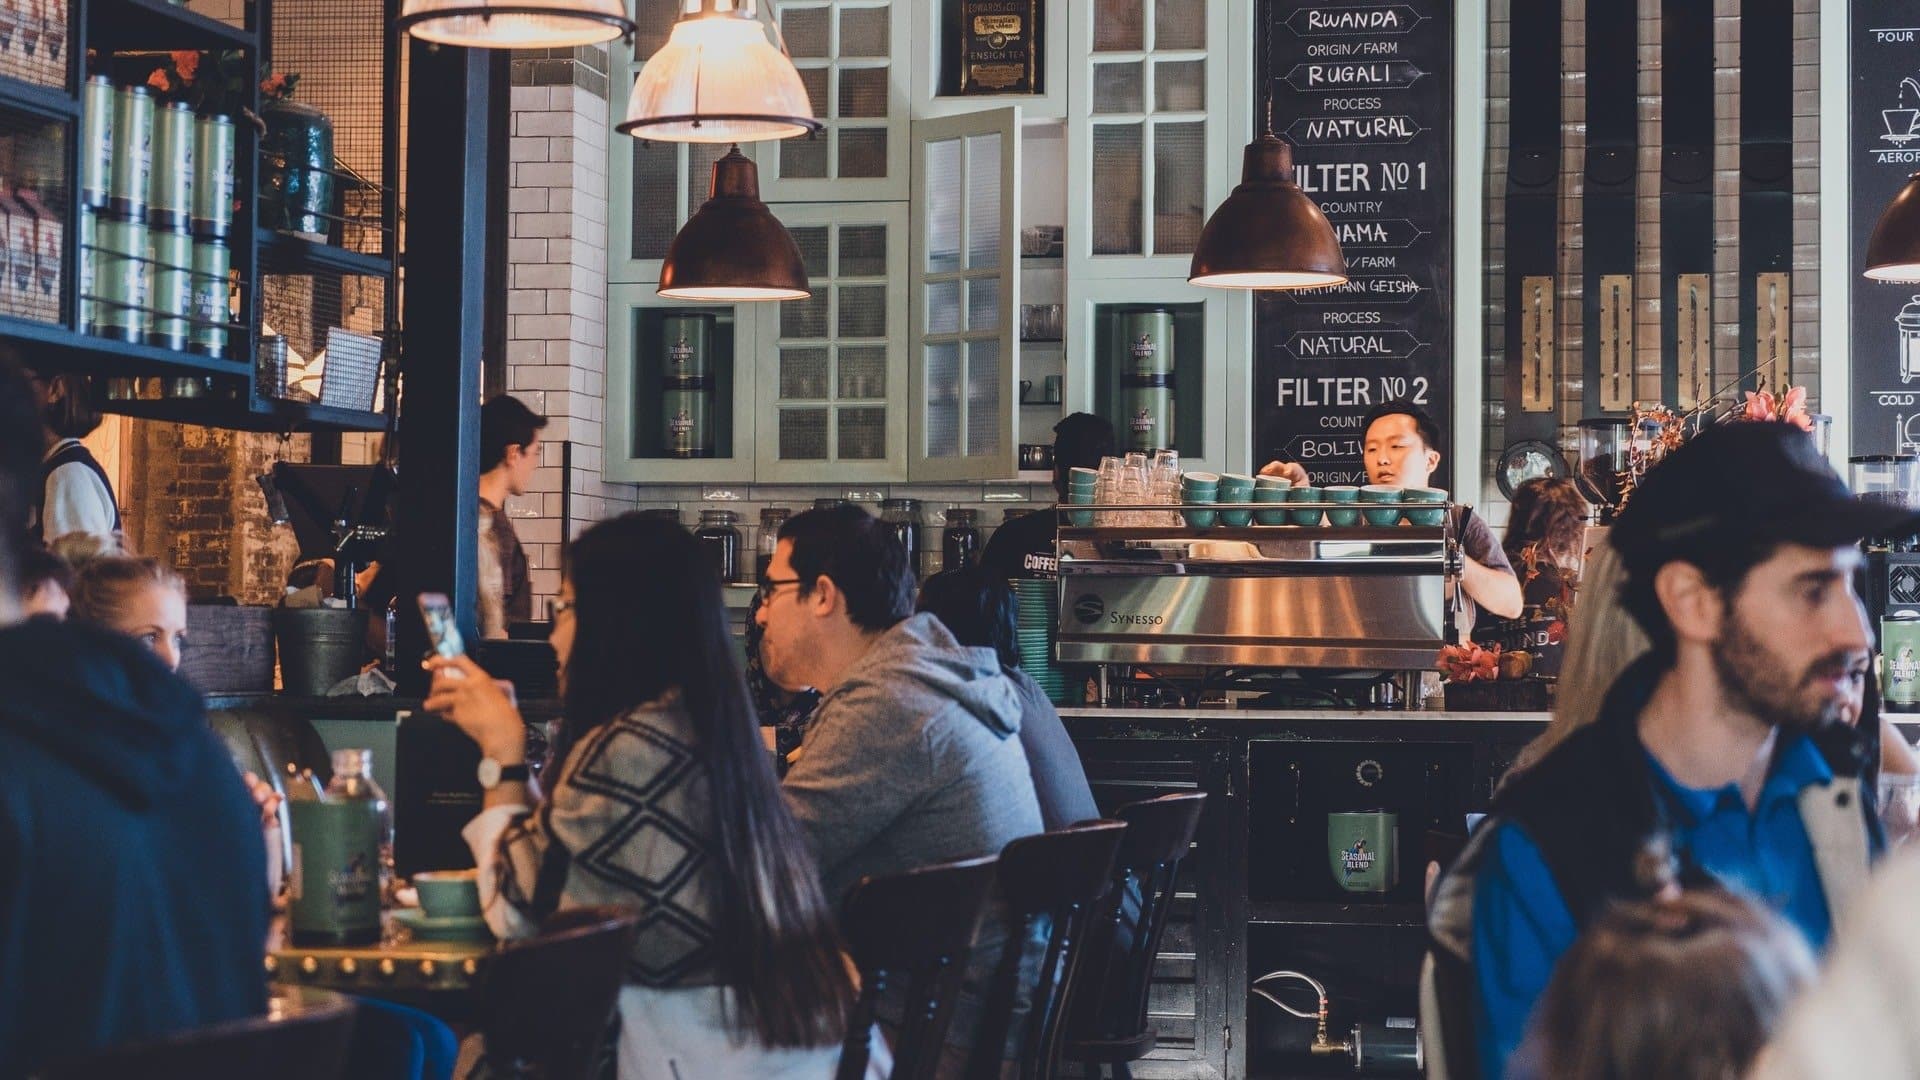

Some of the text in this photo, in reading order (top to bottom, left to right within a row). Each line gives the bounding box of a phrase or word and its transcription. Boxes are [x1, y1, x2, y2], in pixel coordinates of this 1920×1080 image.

[1309, 11, 1397, 29] RWANDA
[1878, 32, 1913, 42] POUR
[1309, 64, 1389, 85] RUGALI
[1324, 98, 1381, 110] PROCESS
[1306, 119, 1412, 139] NATURAL
[1293, 163, 1370, 192] ILTER
[1417, 162, 1427, 191] 1
[1321, 201, 1382, 214] COUNTRY
[1370, 280, 1419, 292] GEISHA
[1324, 312, 1380, 323] PROCESS
[1301, 336, 1391, 355] NATURAL
[1277, 377, 1371, 407] FILTER
[1413, 377, 1428, 404] 2
[1879, 395, 1914, 405] COLD
[1341, 850, 1375, 861] SEASONAL
